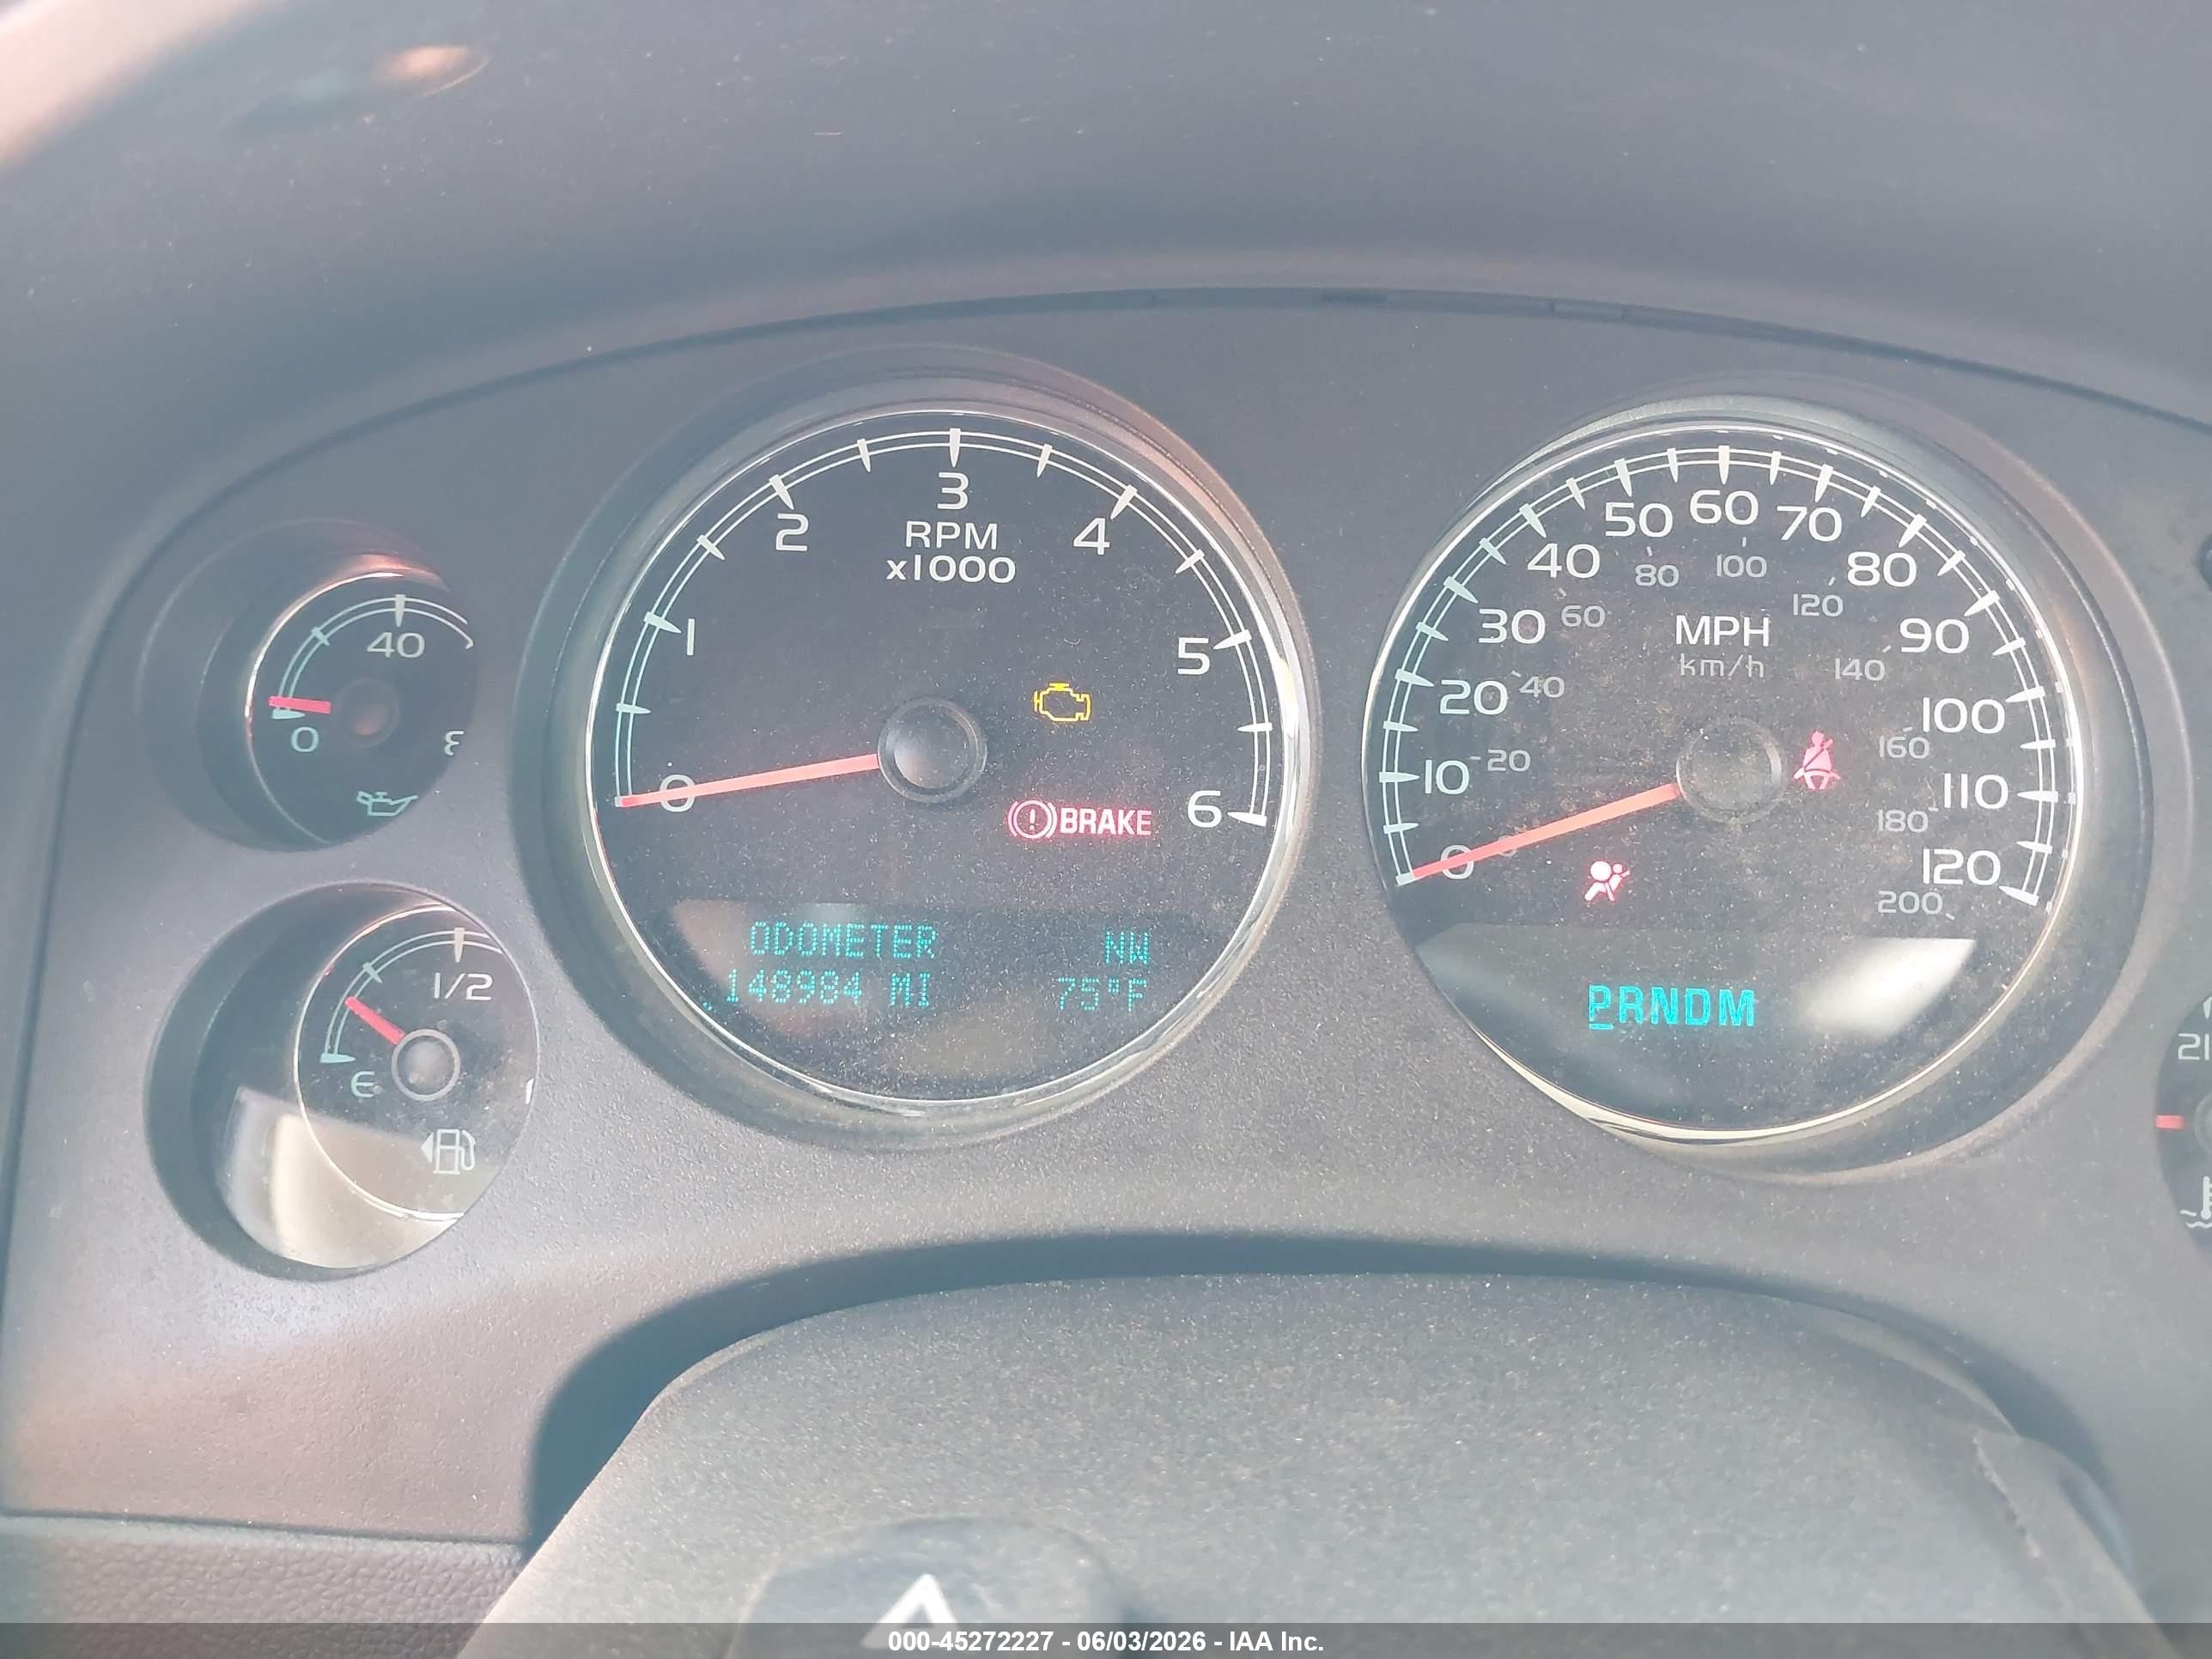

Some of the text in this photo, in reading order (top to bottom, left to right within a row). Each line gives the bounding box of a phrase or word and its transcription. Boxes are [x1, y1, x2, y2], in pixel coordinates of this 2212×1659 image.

[937, 471, 970, 510] 3
[1688, 489, 1759, 526] 60
[775, 513, 811, 551] 2
[904, 520, 999, 550] RPM
[1073, 517, 1111, 556] 4
[1604, 501, 1674, 538] 50
[1776, 506, 1843, 542] 70
[885, 555, 1017, 584] x1000
[1527, 543, 1601, 580] 40
[1634, 563, 1680, 587] 80
[1716, 554, 1767, 579] 100
[1846, 550, 1917, 587] 80
[1560, 605, 1606, 629] 60
[1792, 593, 1844, 617] 120
[686, 617, 696, 656] 1
[1477, 608, 1547, 645] 30
[1674, 615, 1771, 647] MPH
[1899, 617, 1970, 654] 90
[366, 631, 426, 659] 40
[1176, 636, 1211, 676] 5
[1679, 653, 1765, 679] km/h
[1834, 657, 1886, 682] 140
[1439, 679, 1508, 716] 20
[1518, 676, 1565, 699] 40
[1921, 696, 2006, 734] 100
[290, 726, 320, 753] 0
[1878, 735, 1930, 760] 160
[1424, 758, 1470, 795] 10
[1486, 749, 1531, 773] 20
[659, 774, 696, 813] 0
[1187, 789, 1224, 829] 6
[1943, 772, 2009, 810] 110
[1060, 807, 1152, 838] BRAKE
[1876, 809, 1929, 833] 180
[1440, 844, 1474, 880] 0
[1922, 848, 2002, 886] 120
[1876, 890, 1944, 915] 200
[749, 920, 937, 959] ODOMETER
[1104, 931, 1151, 965] NW
[433, 971, 494, 1001] 1/2
[726, 969, 931, 1008] 148984 MI
